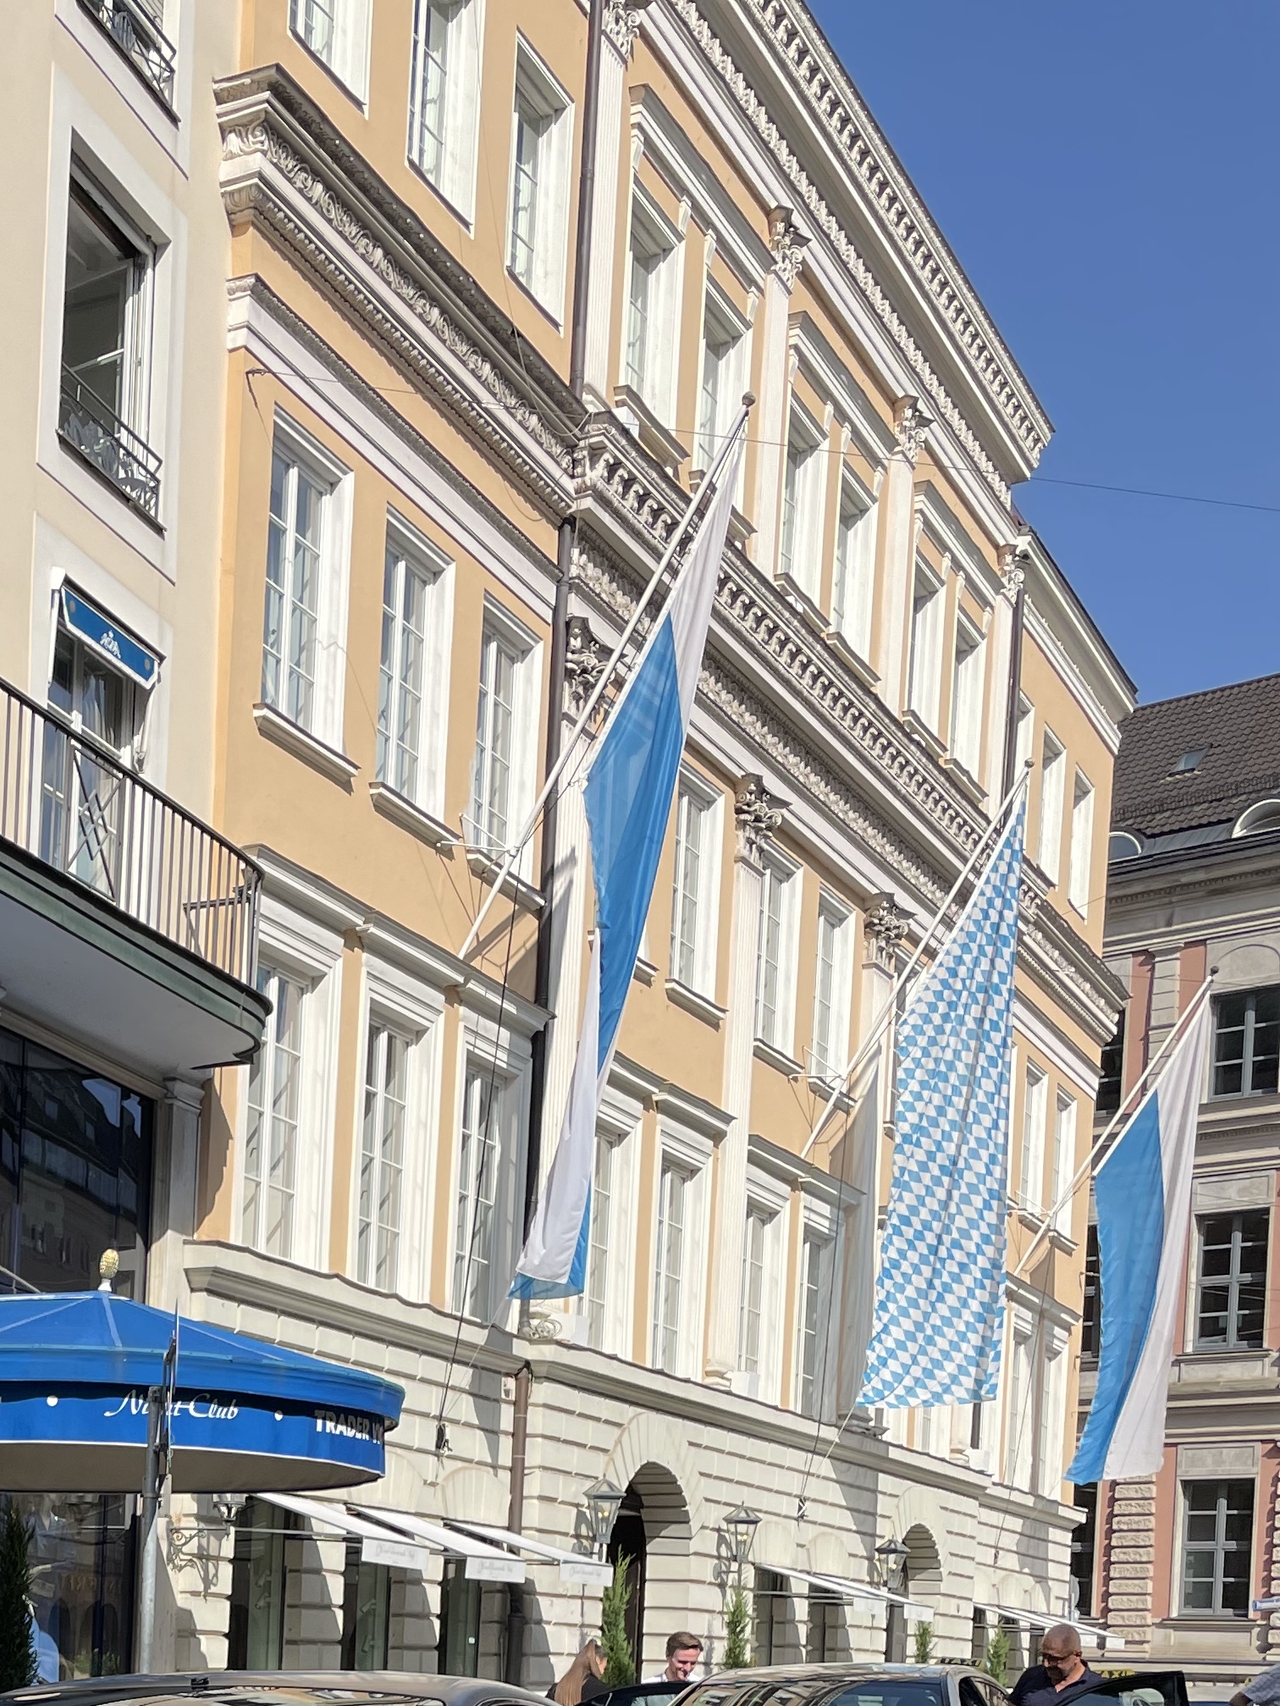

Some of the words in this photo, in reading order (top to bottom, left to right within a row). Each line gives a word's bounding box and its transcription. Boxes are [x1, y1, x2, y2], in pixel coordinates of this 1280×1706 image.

[188, 1392, 239, 1420] Club
[314, 1409, 370, 1441] TRADER
[944, 1657, 981, 1666] TAXI
